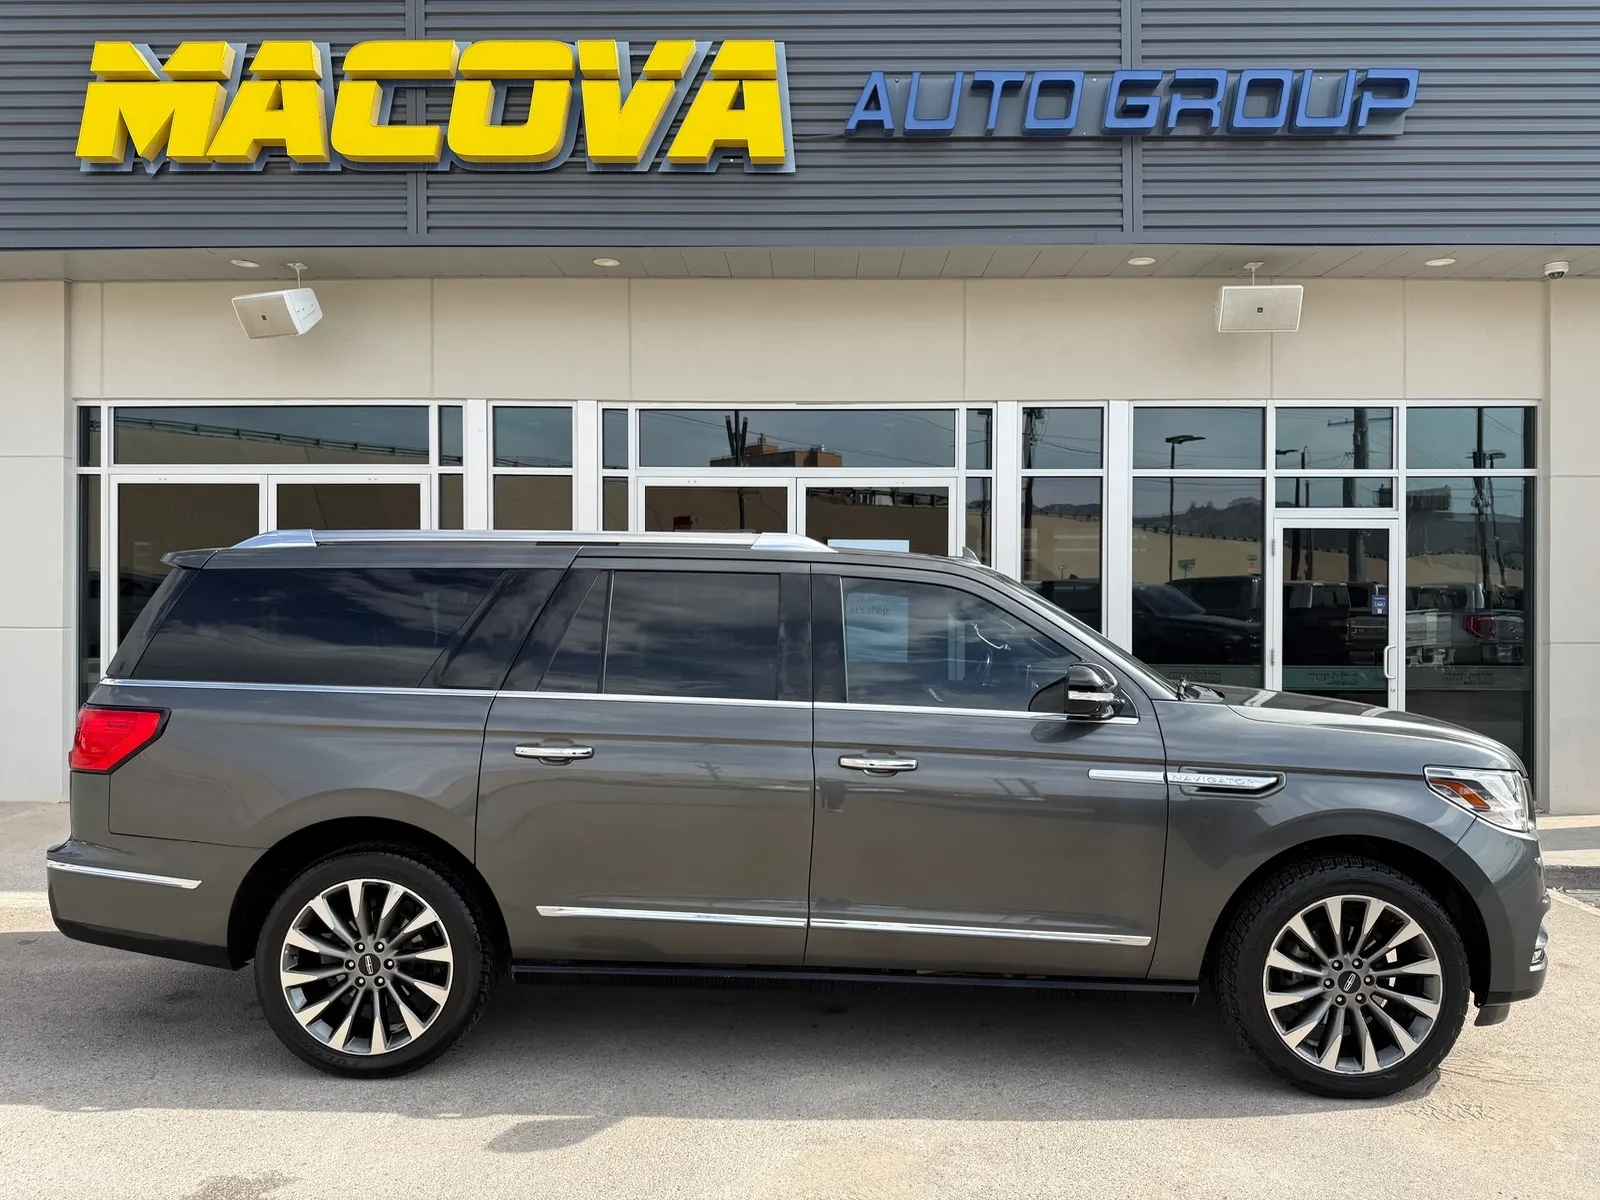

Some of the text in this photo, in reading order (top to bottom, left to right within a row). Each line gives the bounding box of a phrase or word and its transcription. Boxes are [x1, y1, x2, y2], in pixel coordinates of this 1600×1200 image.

[75, 40, 788, 166] MACOVA
[845, 69, 1420, 137] AUTO GROUP
[1172, 774, 1254, 787] NAVIGATOR
